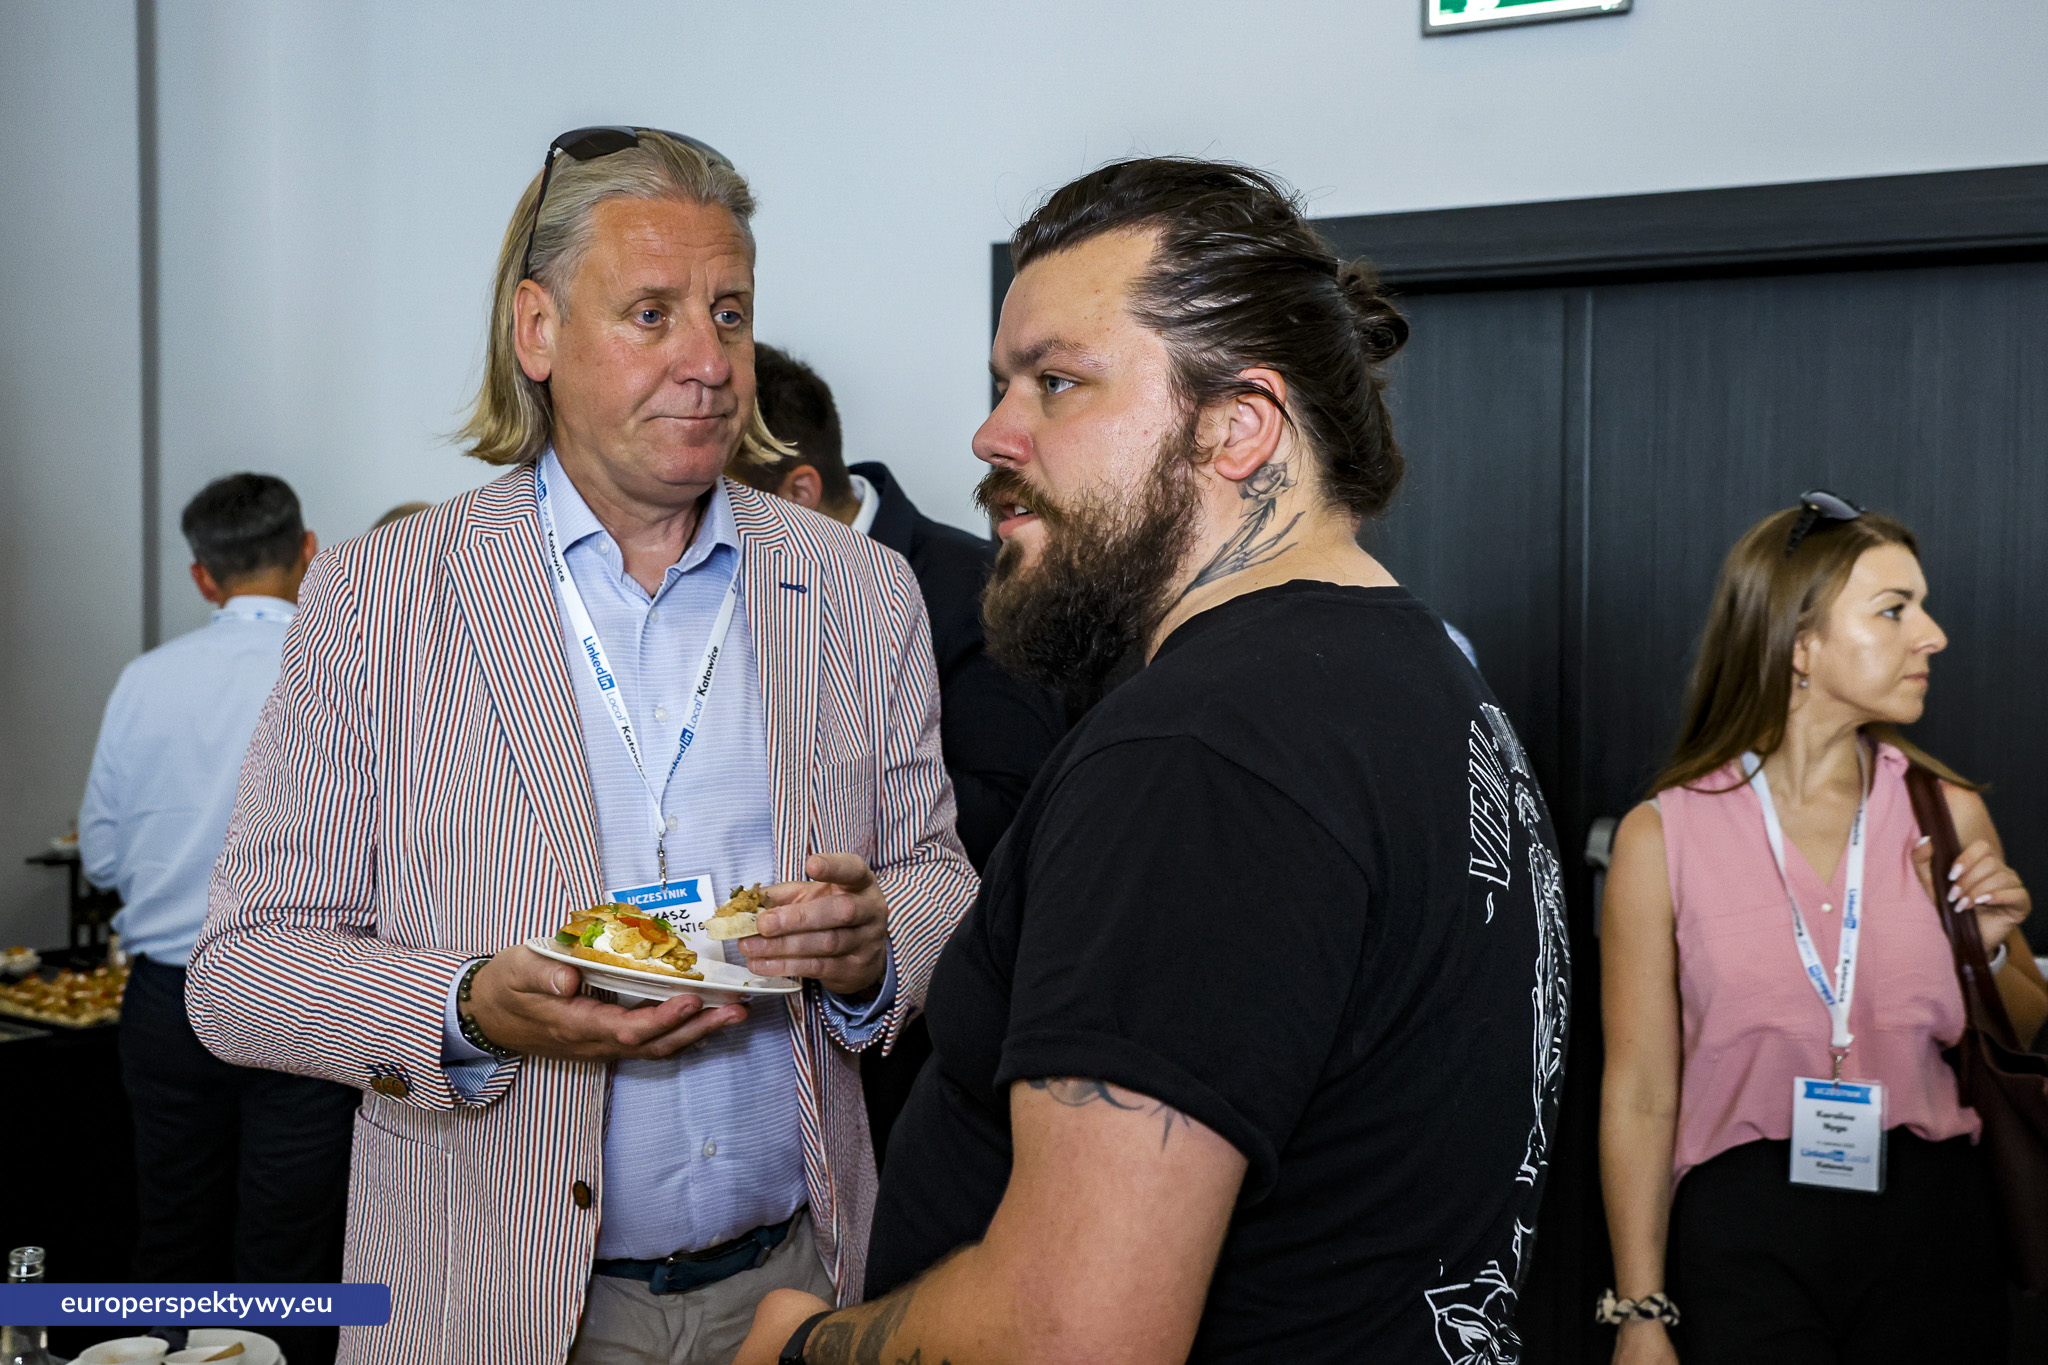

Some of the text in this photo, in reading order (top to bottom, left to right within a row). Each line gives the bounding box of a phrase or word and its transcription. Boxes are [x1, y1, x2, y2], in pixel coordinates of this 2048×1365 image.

[548, 530, 565, 583] Katowice
[696, 646, 719, 697] Katowice
[627, 887, 688, 906] UCZESTNIK
